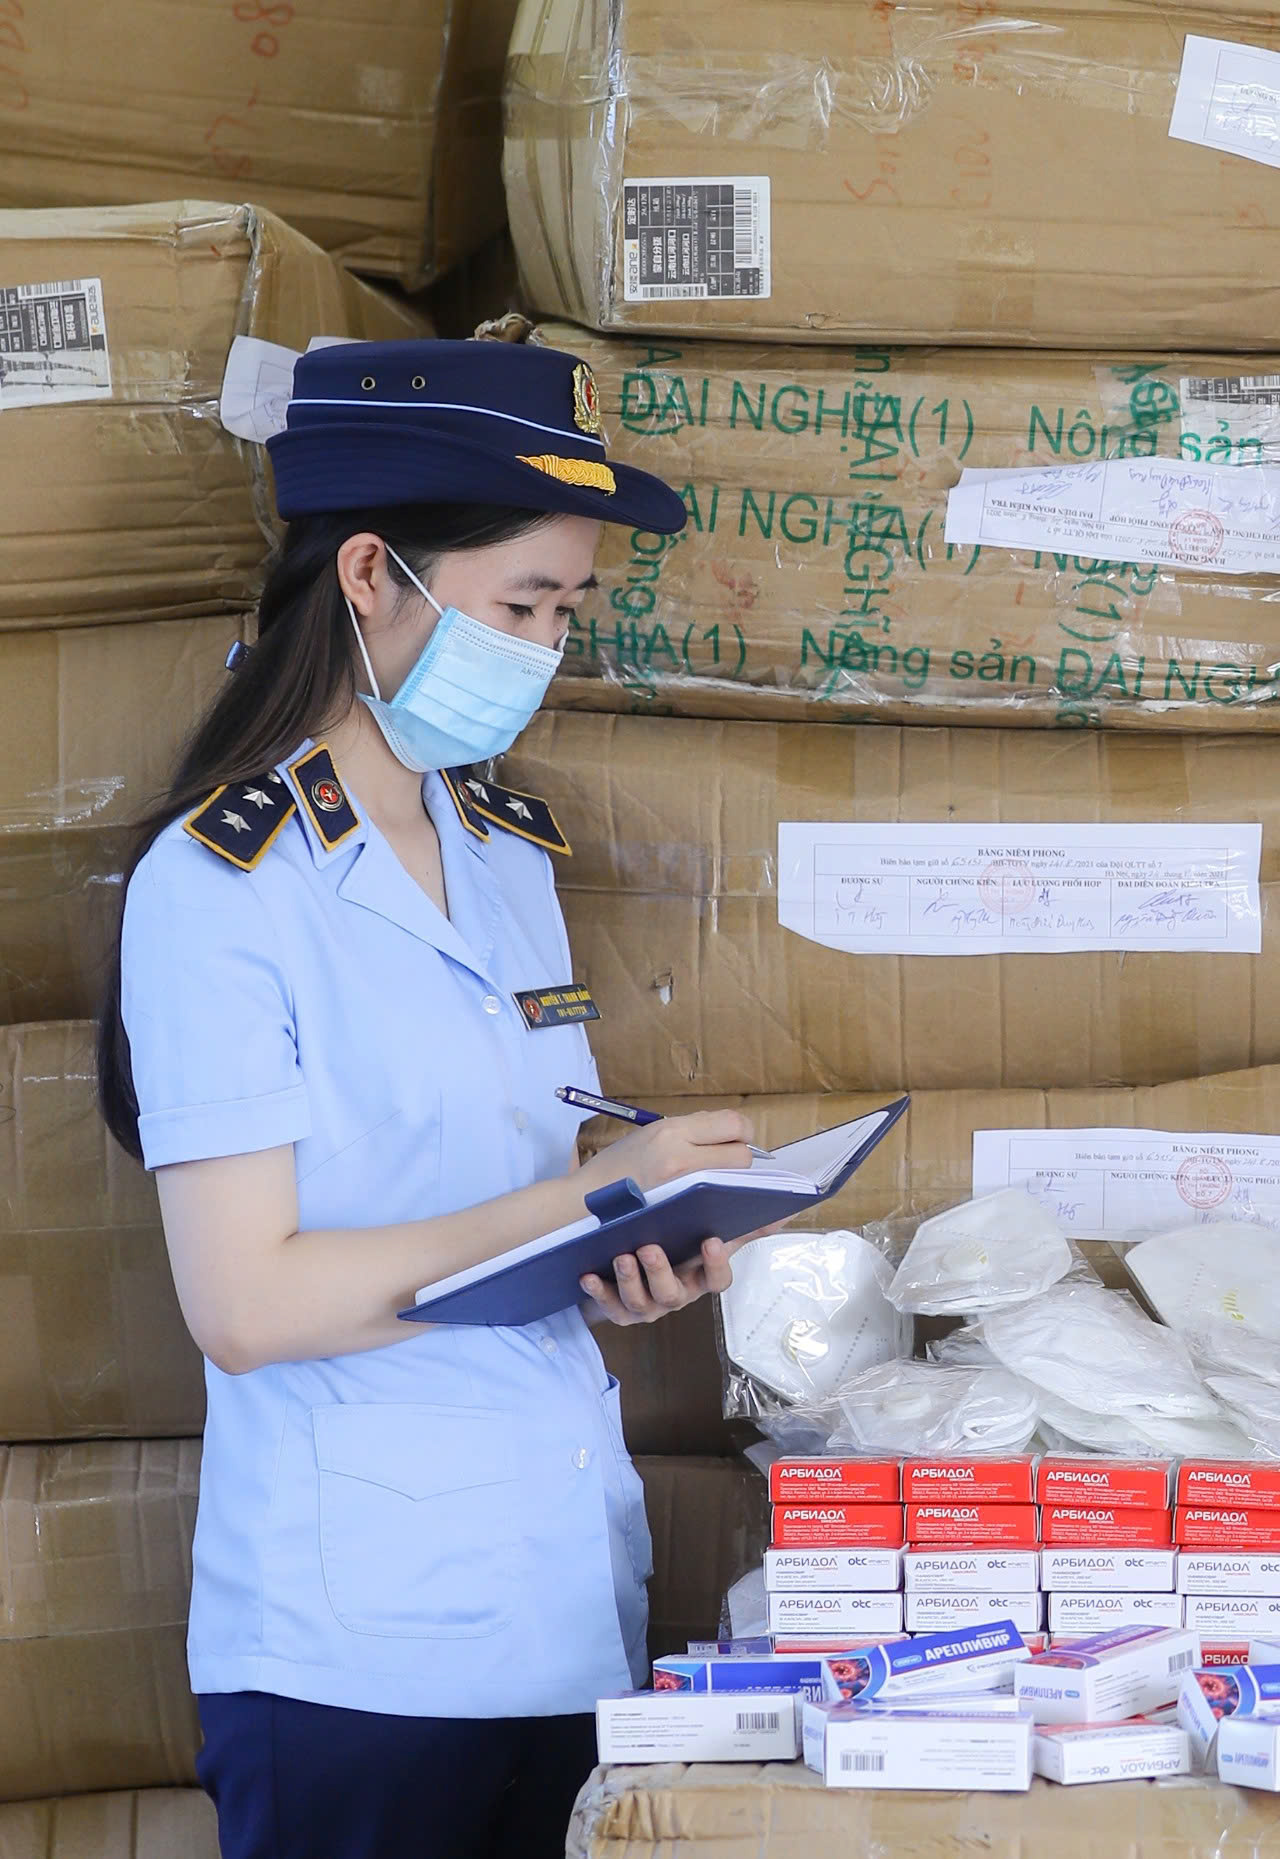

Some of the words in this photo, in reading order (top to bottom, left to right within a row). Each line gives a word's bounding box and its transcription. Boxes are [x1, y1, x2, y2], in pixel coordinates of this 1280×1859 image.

[950, 638, 1036, 684] sản
[779, 1467, 842, 1480] АРБИДОЛ
[911, 1467, 975, 1480] АРБИДОЛ
[1046, 1471, 1110, 1486] АРБИДОЛ
[1188, 1471, 1252, 1486] АРБИДОЛ
[783, 1508, 846, 1521] АРБИДОЛ
[916, 1507, 979, 1521] АРБИДОЛ
[1051, 1509, 1115, 1523] АРБИДОЛ
[1185, 1510, 1249, 1524] АРБИДОЛ
[775, 1557, 839, 1567] АРБИДОЛ
[848, 1557, 868, 1566] otc
[914, 1560, 977, 1571] АРБИДОЛ
[987, 1560, 1007, 1569] otc
[1051, 1557, 1115, 1568] АРБИДОЛ
[1125, 1558, 1145, 1568] otc
[1187, 1561, 1251, 1572] АРБИДОЛ
[1260, 1562, 1280, 1573] otc
[779, 1598, 841, 1610] АРБИДОЛ
[851, 1598, 872, 1609] otc
[916, 1597, 979, 1608] АРБИДОЛ
[988, 1597, 1008, 1608] otc
[1060, 1598, 1123, 1609] АРБИДОЛ
[1133, 1598, 1153, 1609] otc
[1195, 1601, 1259, 1613] АРБИДОЛ
[925, 1634, 1011, 1662] АРЕПЛИВИР
[1201, 1653, 1248, 1665] АРБИДО
[1019, 1686, 1063, 1700] АРЕПЛИВИР
[1120, 1758, 1182, 1778] АРБИДОЛ
